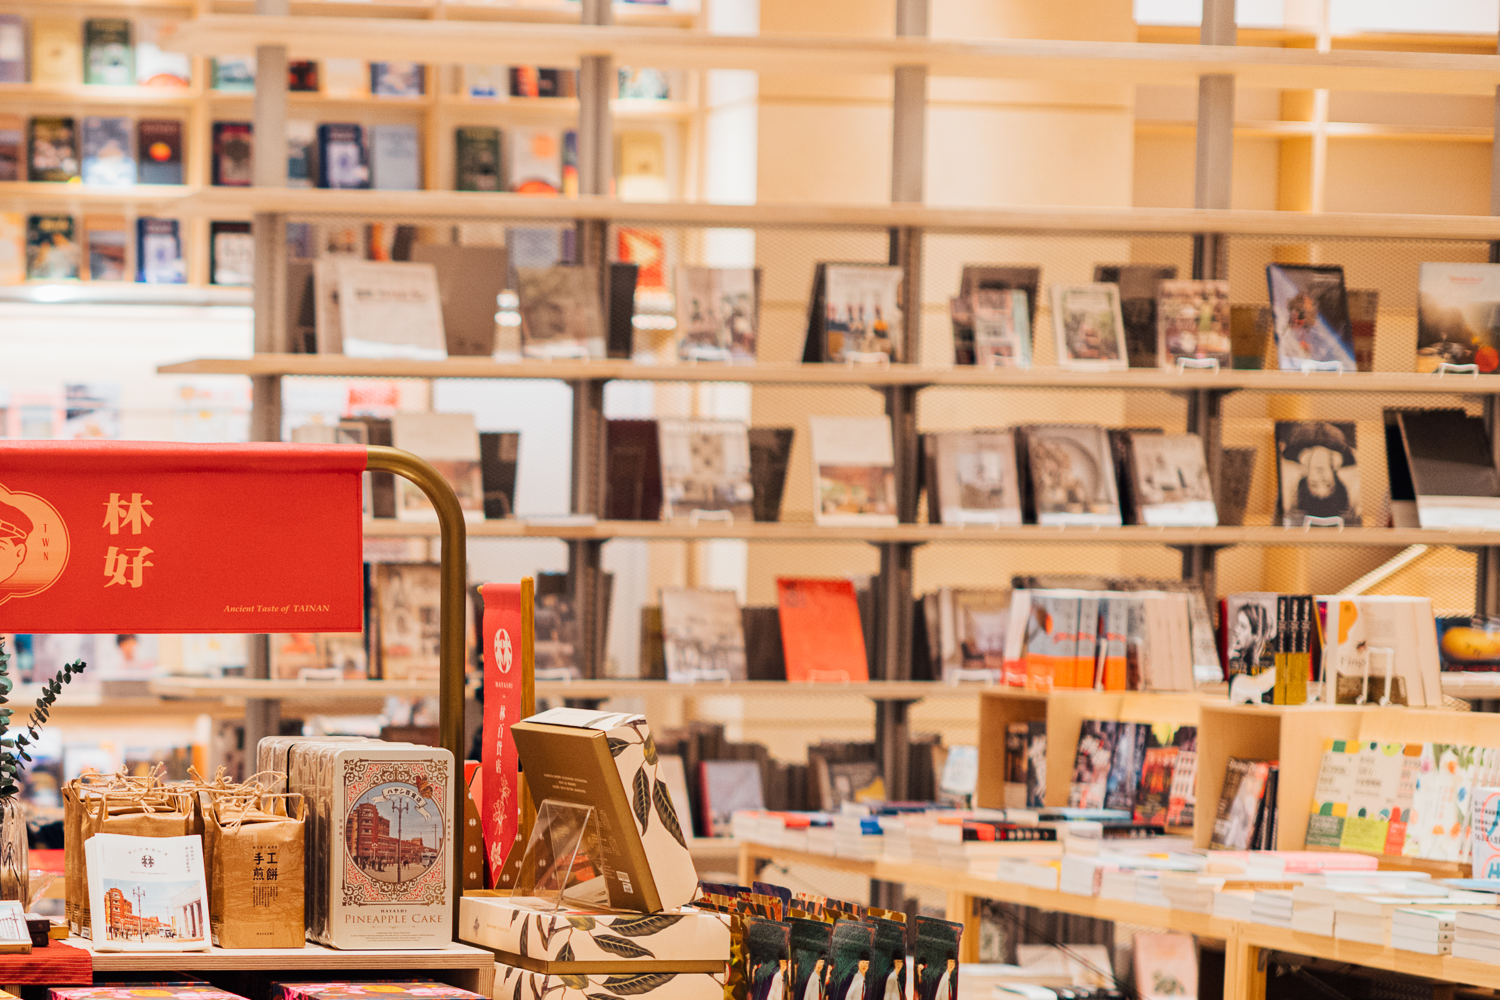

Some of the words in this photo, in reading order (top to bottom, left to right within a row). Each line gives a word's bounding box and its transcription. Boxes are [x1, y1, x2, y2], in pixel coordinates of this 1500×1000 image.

[41, 522, 50, 562] TWN
[101, 492, 155, 589] 林好
[223, 605, 255, 613] Ancient
[256, 604, 279, 612] Taste
[280, 604, 291, 615] of
[293, 604, 330, 612] TAINAN
[495, 704, 506, 774] 林百貨店
[345, 914, 407, 924] PINEAPPLE
[411, 913, 443, 924] CAKE
